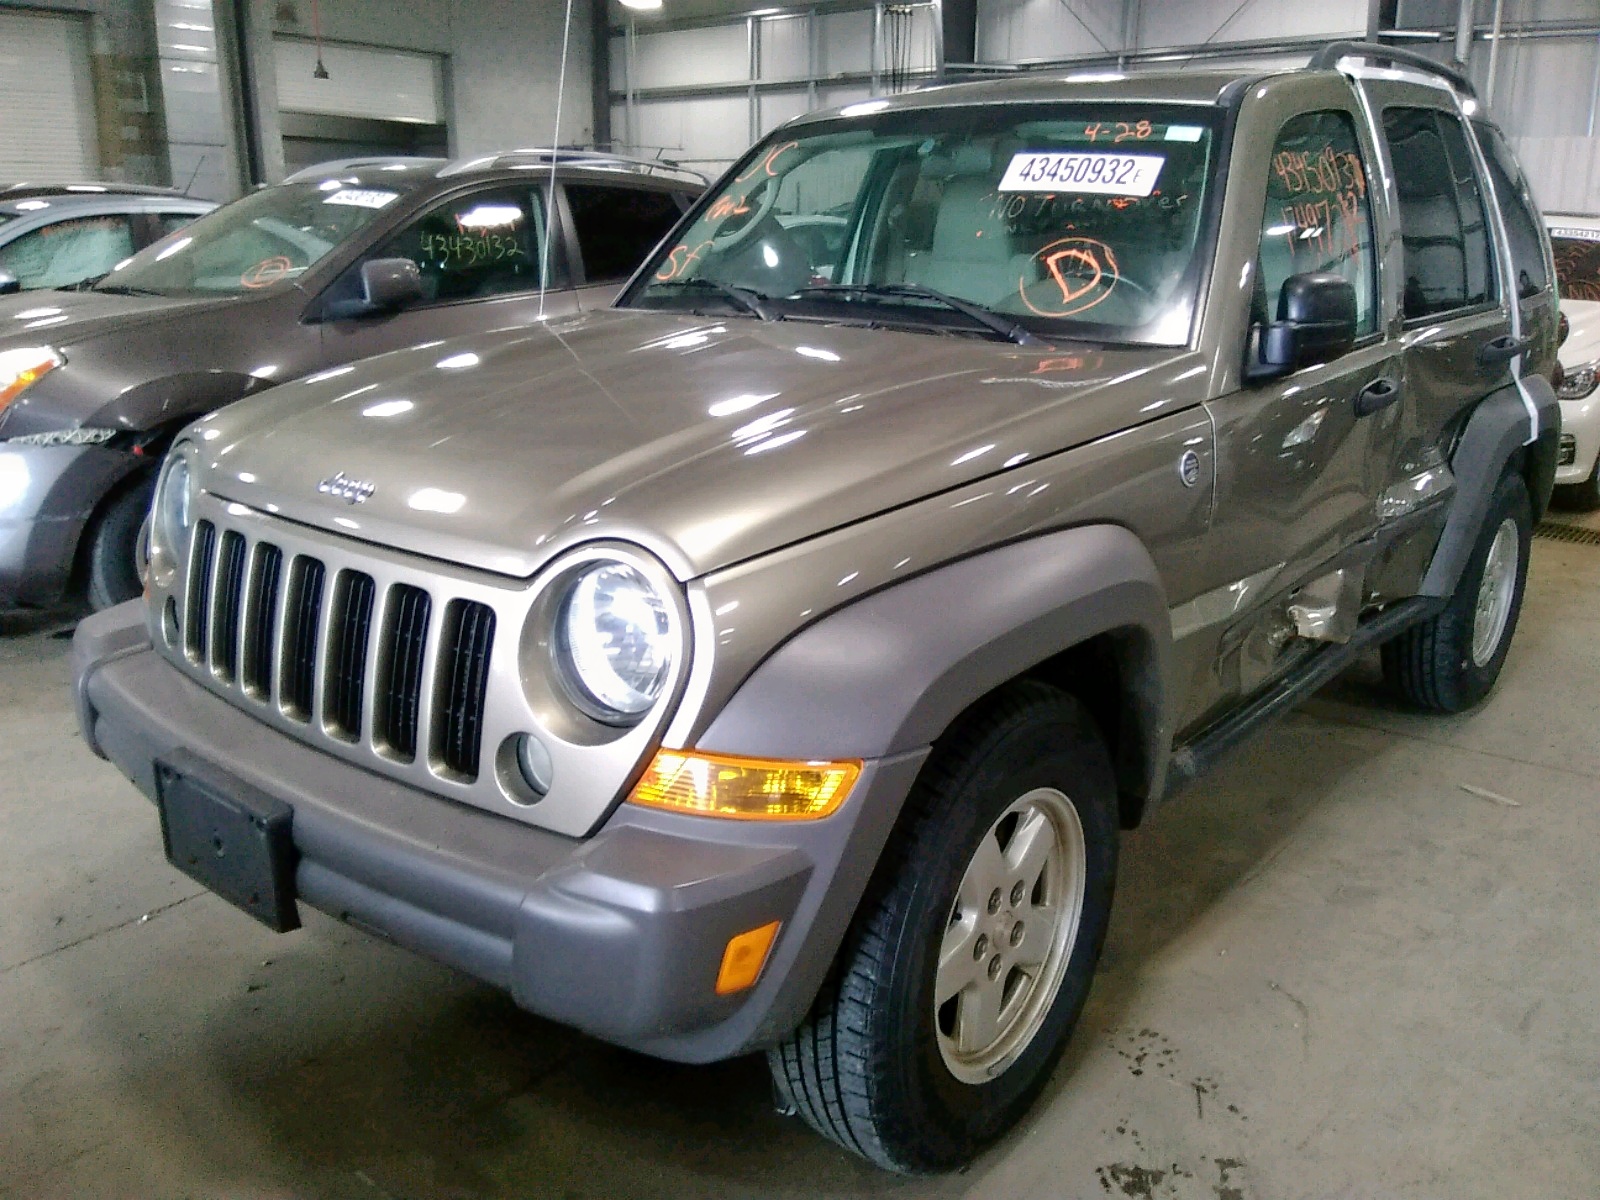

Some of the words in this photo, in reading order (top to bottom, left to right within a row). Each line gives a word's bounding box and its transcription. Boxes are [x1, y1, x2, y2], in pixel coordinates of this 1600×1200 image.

[1084, 120, 1152, 142] 4-28
[1018, 157, 1136, 185] 43450932
[420, 231, 524, 264] 43430132
[316, 471, 375, 505] Jeep
